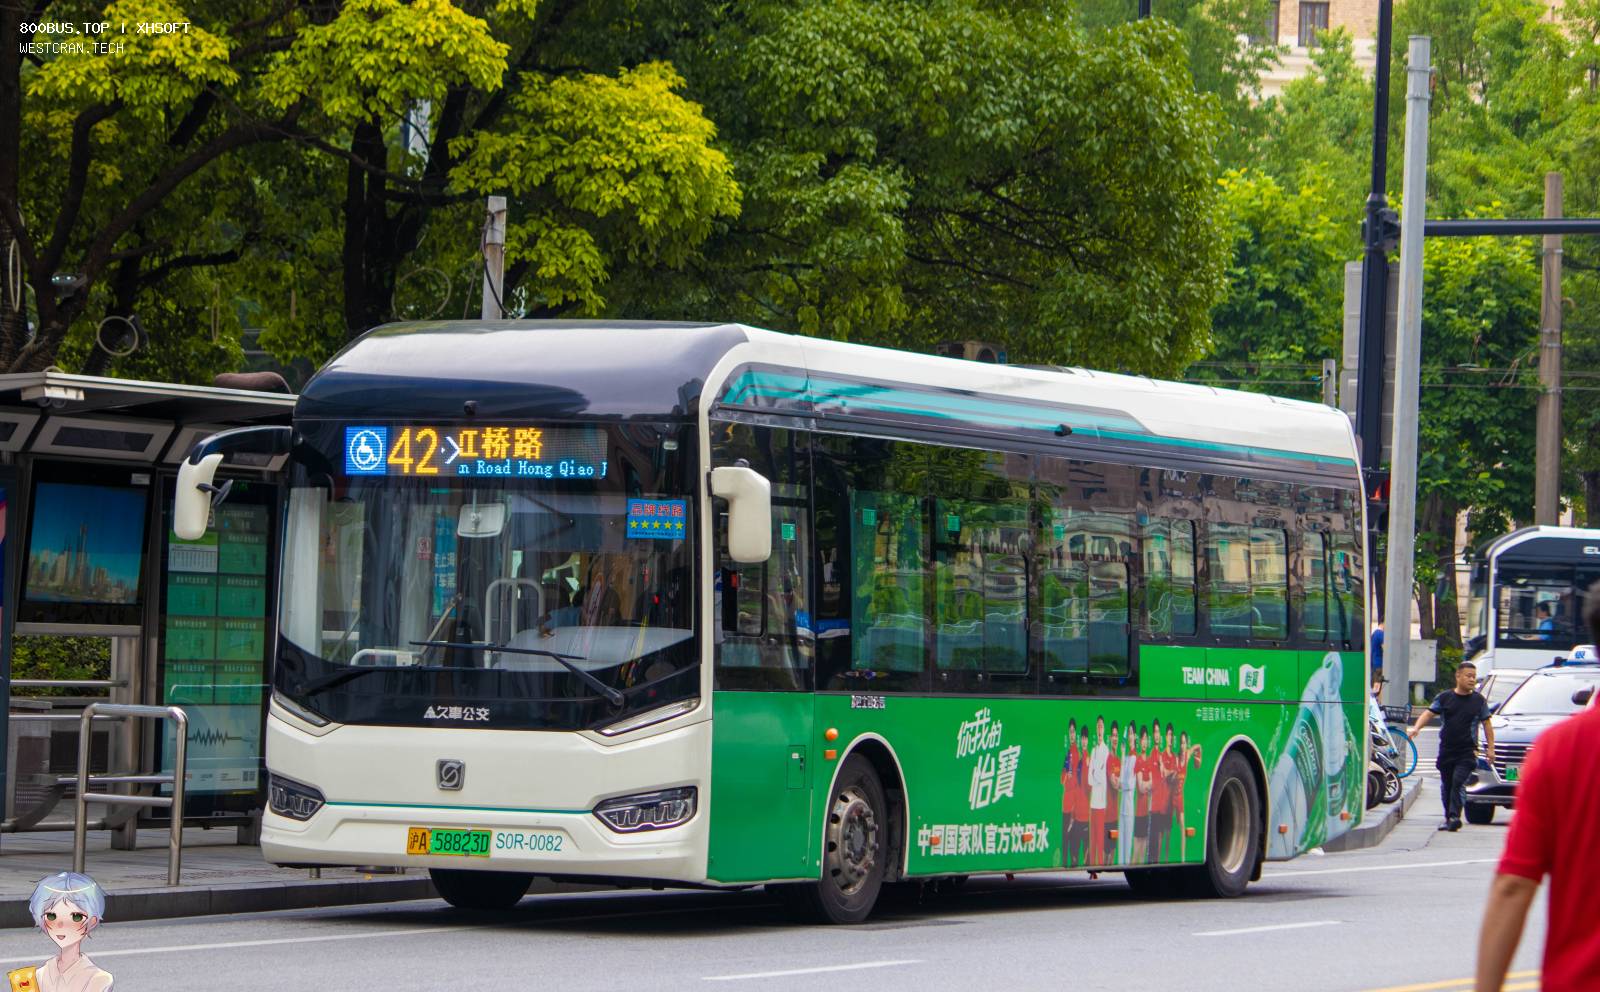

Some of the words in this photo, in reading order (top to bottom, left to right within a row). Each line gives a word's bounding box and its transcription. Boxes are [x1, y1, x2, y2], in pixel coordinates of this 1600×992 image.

[387, 428, 438, 474] 42
[476, 460, 512, 474] Road
[518, 461, 553, 477] Hong
[559, 460, 594, 477] Qiao
[1182, 667, 1204, 685] TEAM
[1206, 668, 1230, 686] CHINA
[956, 707, 1002, 758] 你我的
[434, 832, 490, 853] 58823D
[918, 821, 1049, 857] 中国国家队官方饮用水
